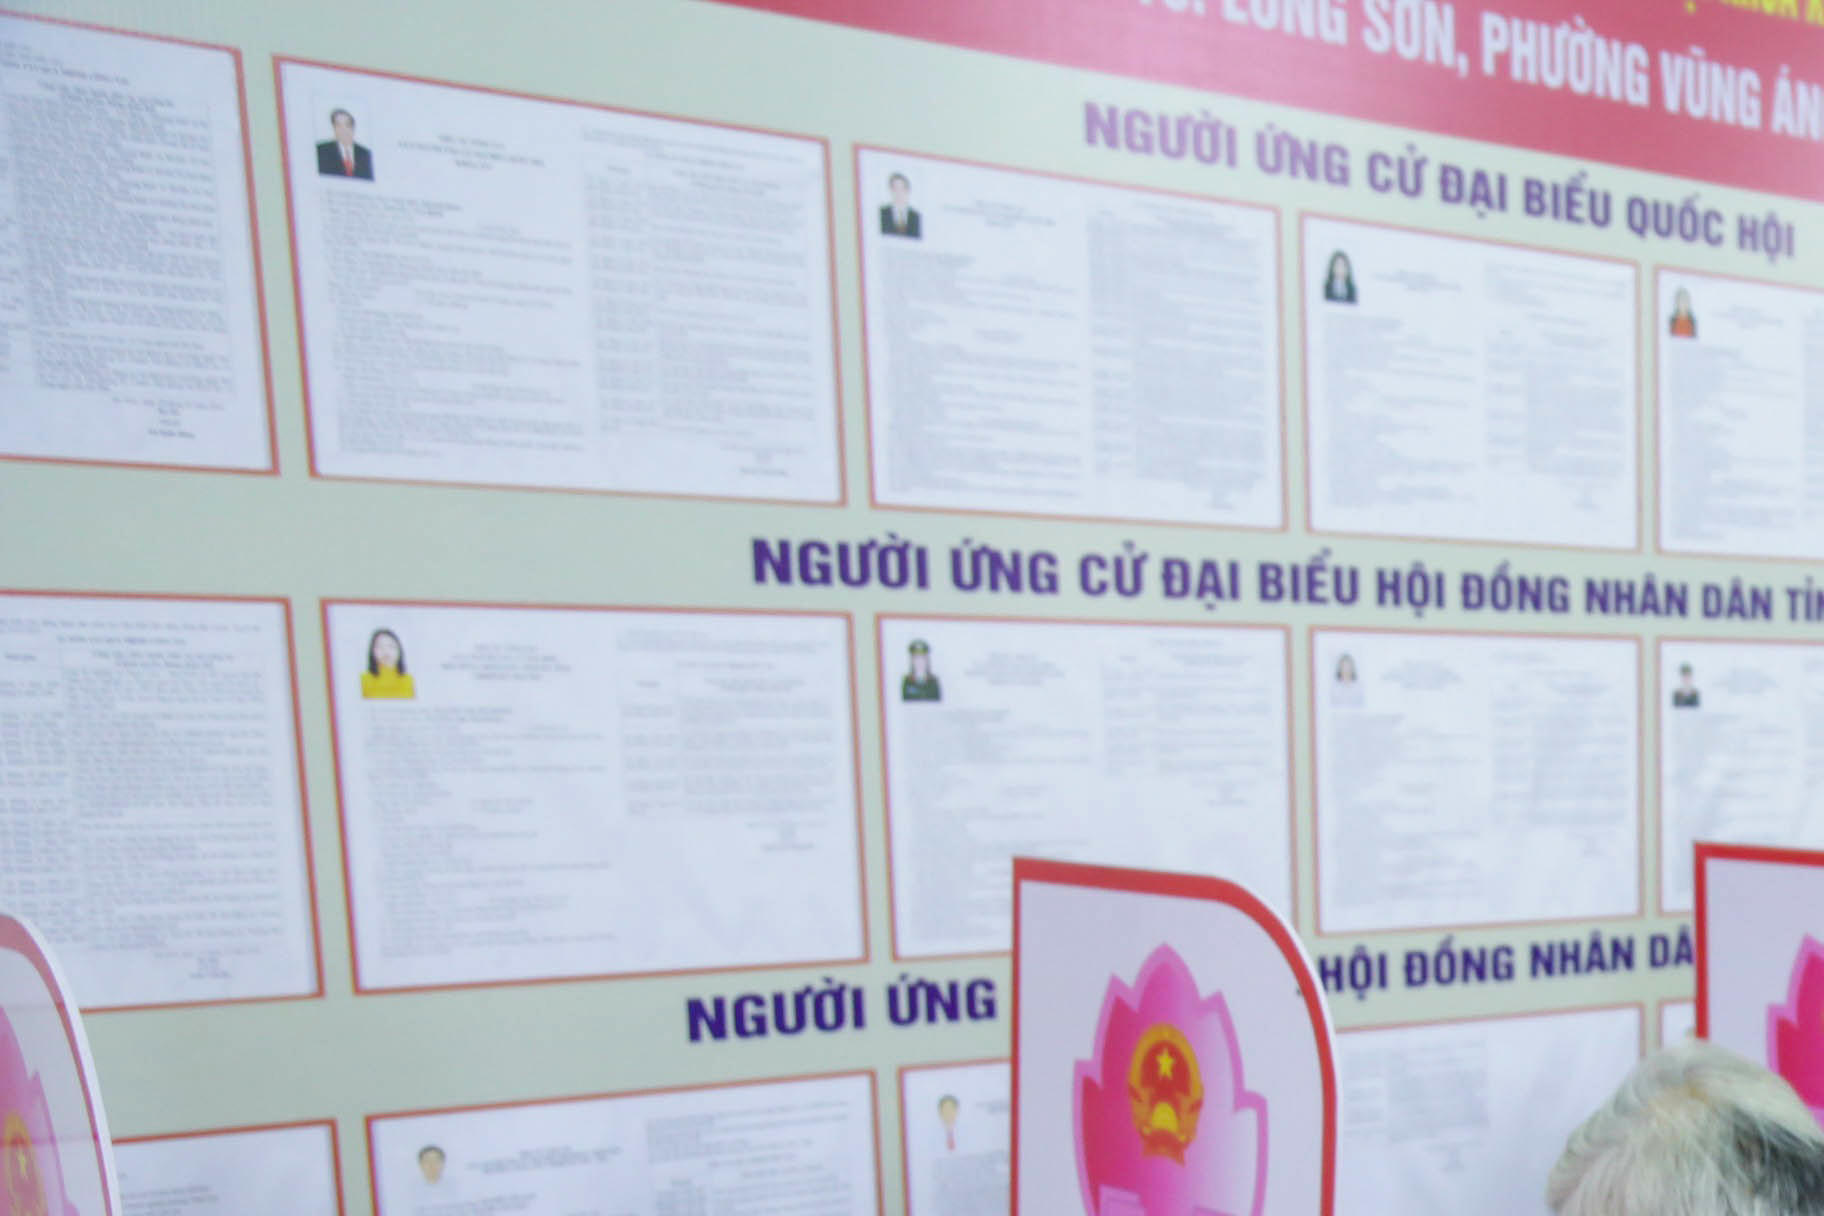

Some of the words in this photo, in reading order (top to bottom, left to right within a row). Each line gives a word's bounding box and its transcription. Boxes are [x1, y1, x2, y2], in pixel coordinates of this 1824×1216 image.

[1480, 10, 1651, 108] PHƯỜNG
[1659, 43, 1763, 130] VŨNG
[1084, 99, 1239, 171] NGƯỜI
[1256, 120, 1351, 188] ỨNG
[1367, 142, 1429, 199] CỬ
[1439, 162, 1507, 219] ĐẠI
[1523, 169, 1613, 229] BIỂU
[1626, 190, 1725, 248] QUỐC
[1737, 211, 1796, 264] HỘI
[751, 531, 930, 591] NGƯỜI
[950, 537, 1059, 595] ỨNG
[1079, 540, 1149, 597] CỬ
[1161, 556, 1241, 612] ĐẠI
[1258, 546, 1360, 605] BIỂU
[1375, 560, 1445, 619] HỘI
[1585, 571, 1689, 620] NHÂN
[1702, 576, 1774, 622] DÂN
[686, 976, 867, 1044] NGƯỜI
[887, 973, 998, 1027] ỨNG
[1317, 944, 1389, 1003] HỘI
[1529, 929, 1636, 980] NHÂN
[1649, 923, 1694, 970] DÂ
